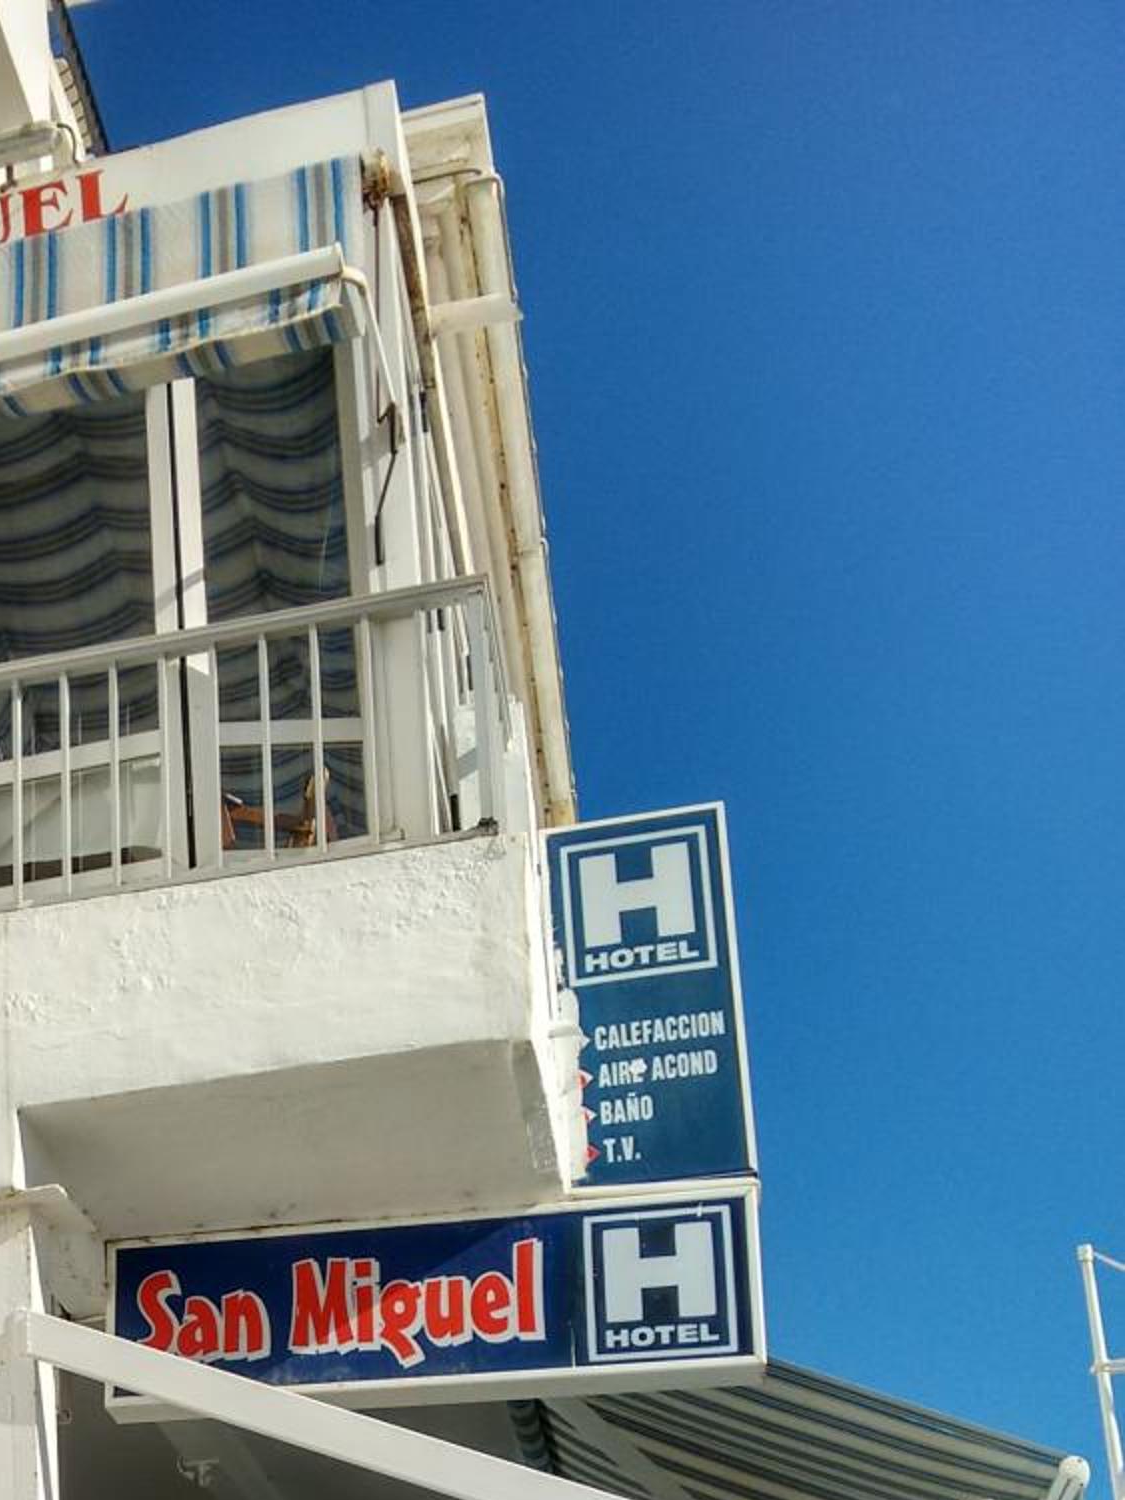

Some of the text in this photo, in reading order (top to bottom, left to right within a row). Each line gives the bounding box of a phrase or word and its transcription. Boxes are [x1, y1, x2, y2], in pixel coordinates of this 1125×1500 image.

[578, 841, 696, 949] H
[584, 940, 700, 973] HOTEL
[594, 1010, 725, 1051] CALEFACCION
[651, 1049, 718, 1082] ACOND
[600, 1092, 654, 1126] BAÑO
[602, 1135, 642, 1163] T.V.
[602, 1221, 717, 1323] H
[134, 1237, 546, 1369] San Miguel
[605, 1323, 720, 1349] HOTEL
